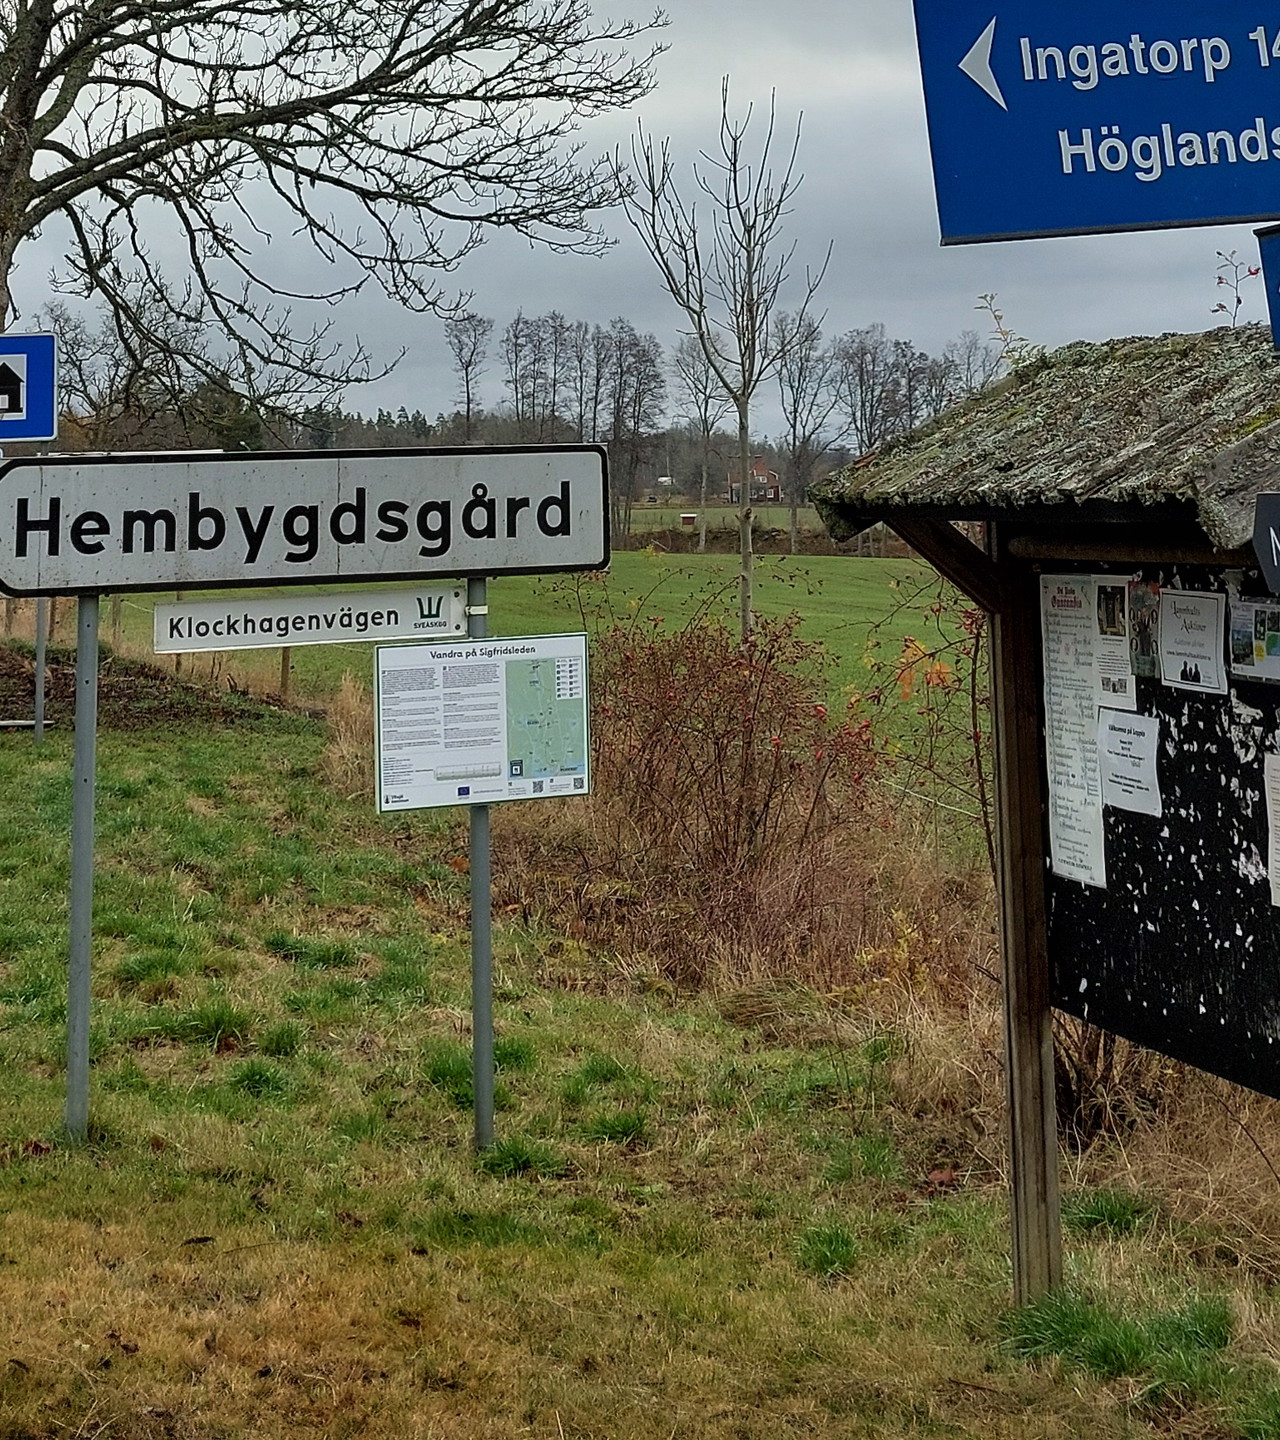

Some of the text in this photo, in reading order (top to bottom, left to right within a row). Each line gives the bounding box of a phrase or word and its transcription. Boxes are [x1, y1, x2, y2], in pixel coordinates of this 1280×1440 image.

[1019, 31, 1232, 91] Ingatorp
[14, 479, 574, 565] Hembygdsgård
[168, 607, 400, 639] Klockhagenvägen
[429, 645, 536, 660] Vandra på Sigfridsleden
